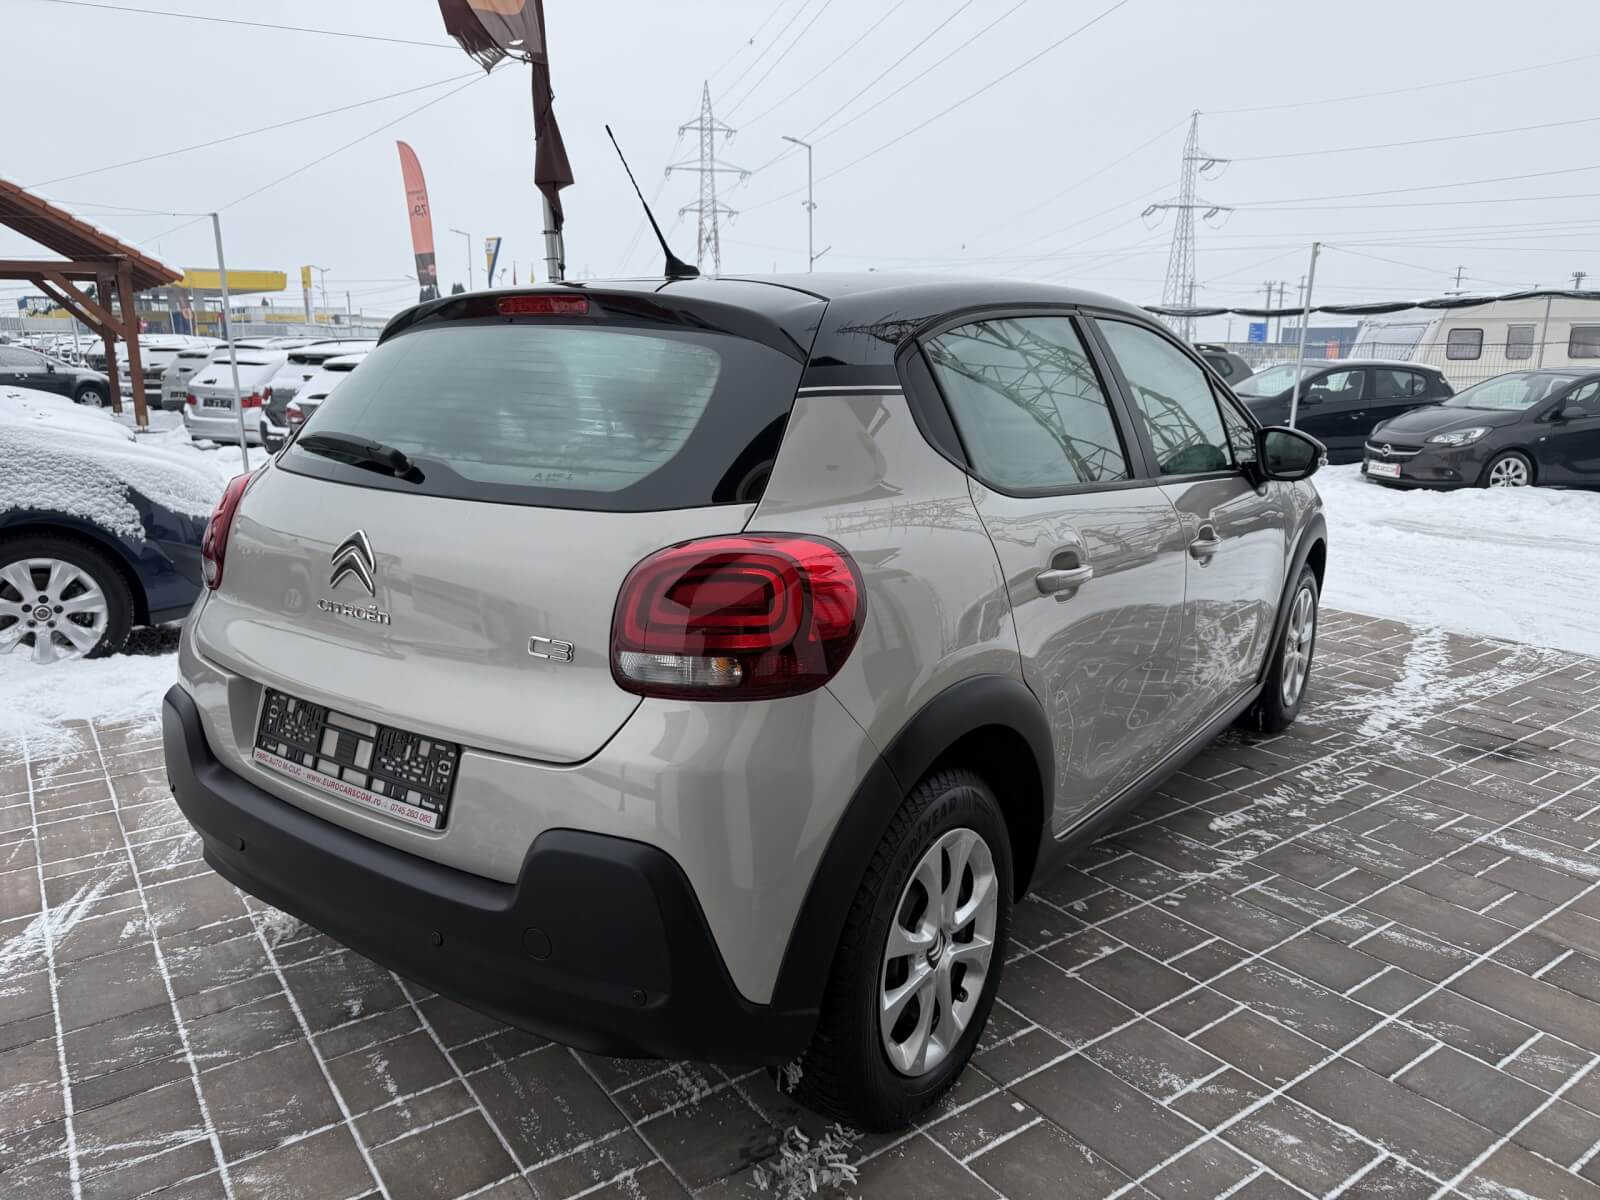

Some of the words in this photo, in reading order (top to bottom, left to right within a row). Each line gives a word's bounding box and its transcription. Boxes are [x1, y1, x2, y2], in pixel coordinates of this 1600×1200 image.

[317, 599, 391, 625] CITROËN
[527, 635, 575, 664] C3
[256, 751, 269, 762] PARC
[269, 757, 283, 769] AUTO
[282, 762, 302, 776] M-CIUC
[390, 803, 406, 815] 0745
